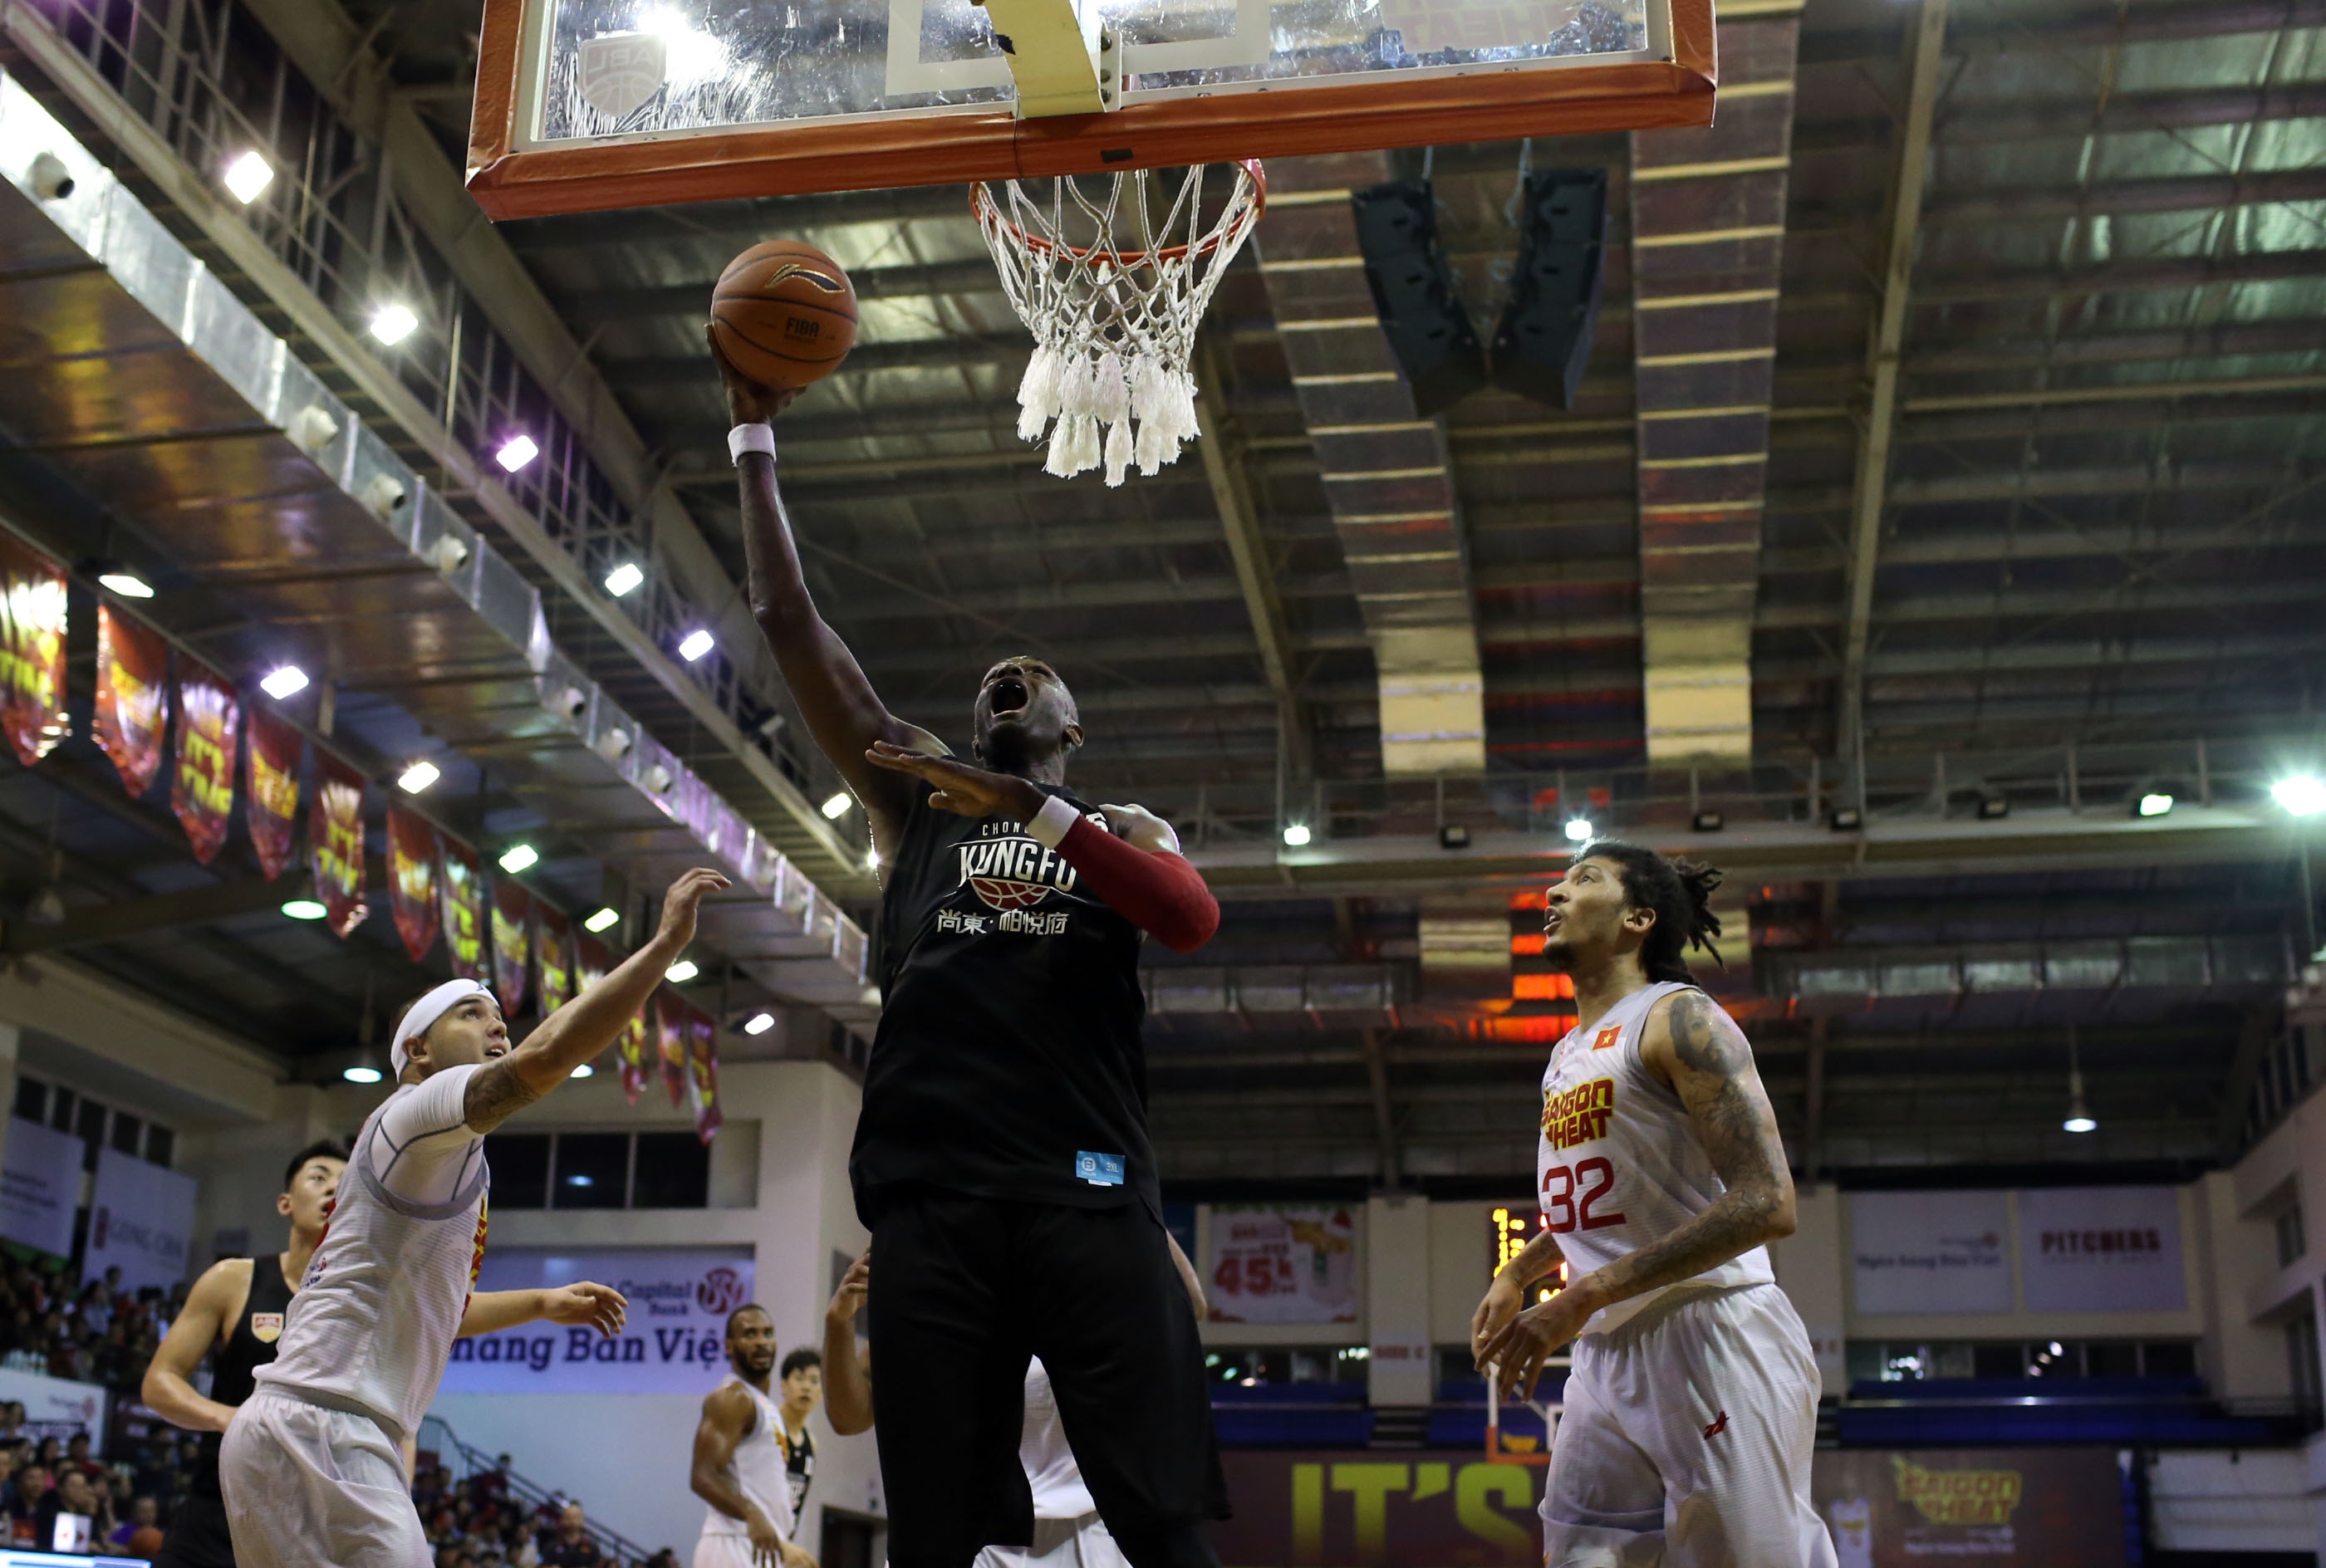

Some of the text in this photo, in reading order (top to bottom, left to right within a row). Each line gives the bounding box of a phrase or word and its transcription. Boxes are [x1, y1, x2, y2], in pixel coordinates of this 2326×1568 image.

[785, 316, 820, 337] FIBA
[982, 821, 1031, 836] CHON
[958, 840, 1077, 893] KUNGFU
[1541, 1076, 1614, 1128] SAIGON
[1551, 1108, 1613, 1152] HEAT
[1542, 1156, 1627, 1234] 32
[1291, 1461, 1533, 1567] IT'S
